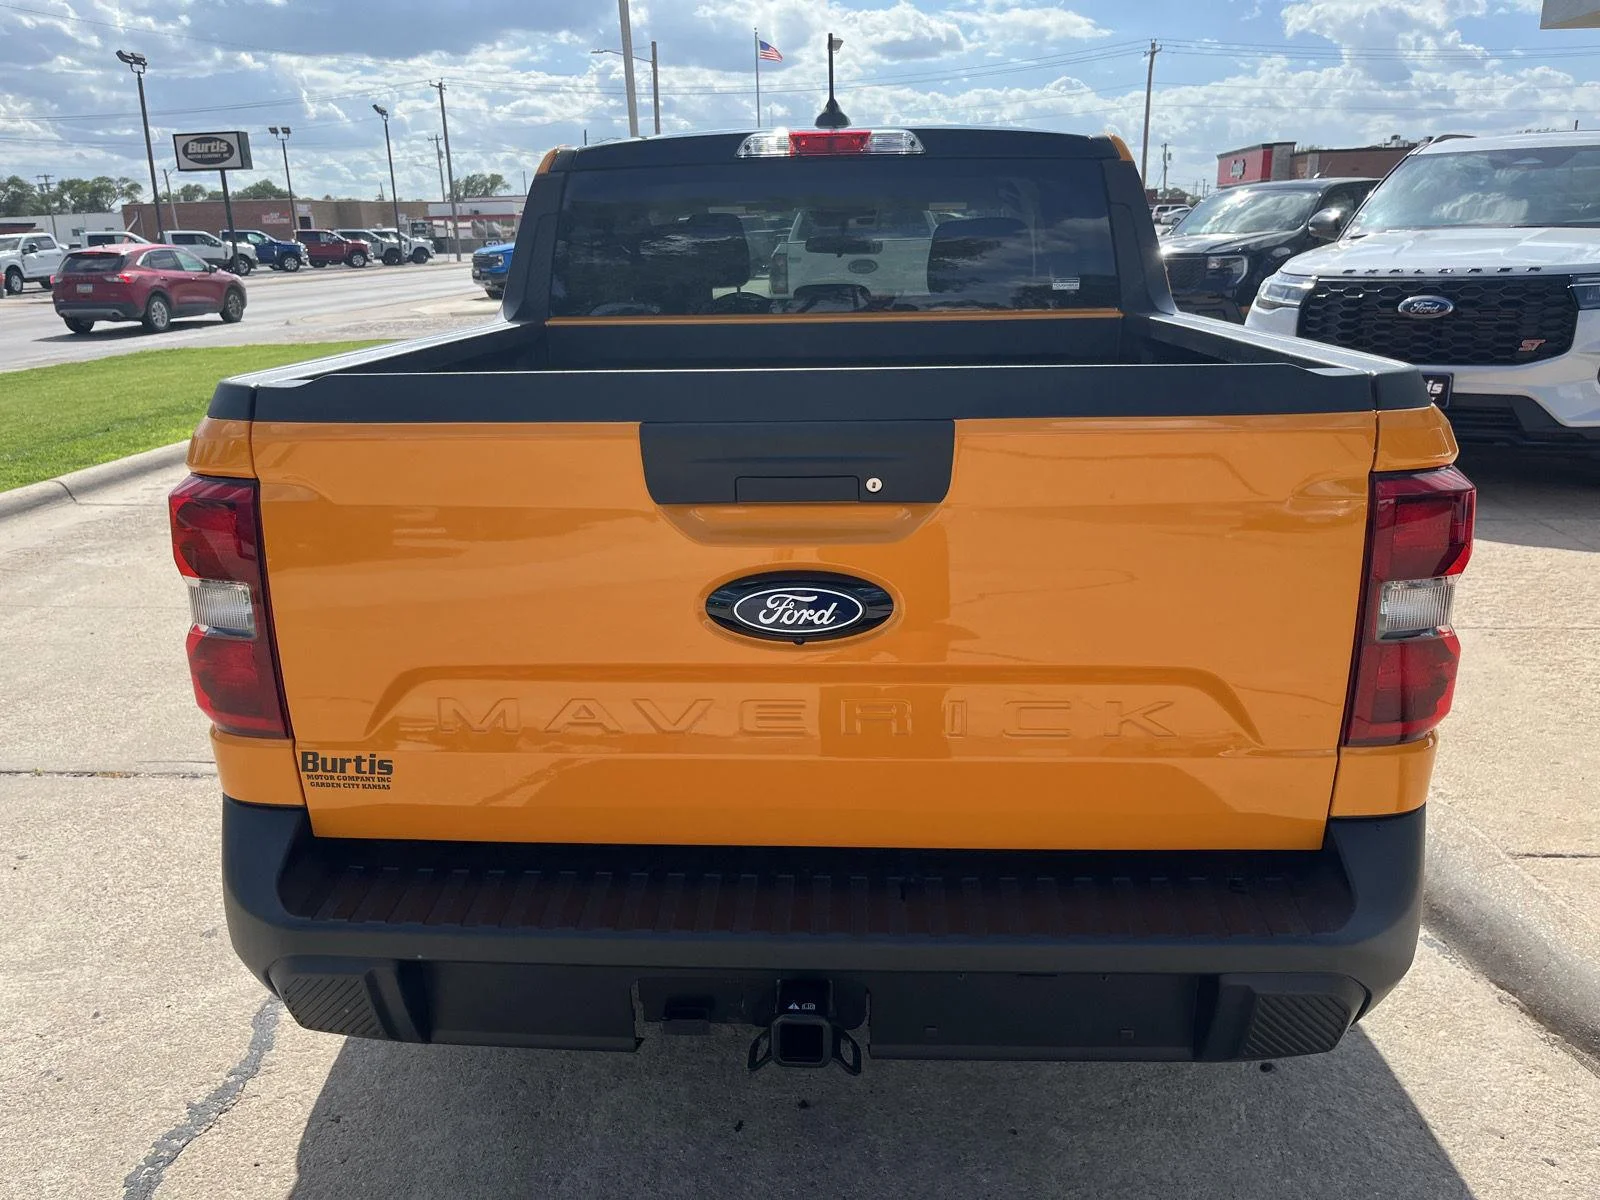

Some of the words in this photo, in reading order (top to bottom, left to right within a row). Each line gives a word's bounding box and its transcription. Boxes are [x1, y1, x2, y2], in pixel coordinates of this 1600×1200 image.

[188, 141, 228, 153] Burtis
[1410, 301, 1440, 313] Ford
[1518, 339, 1546, 352] ST
[758, 593, 836, 625] Ford
[437, 695, 1178, 739] MAVERICK
[301, 751, 393, 775] Burtis
